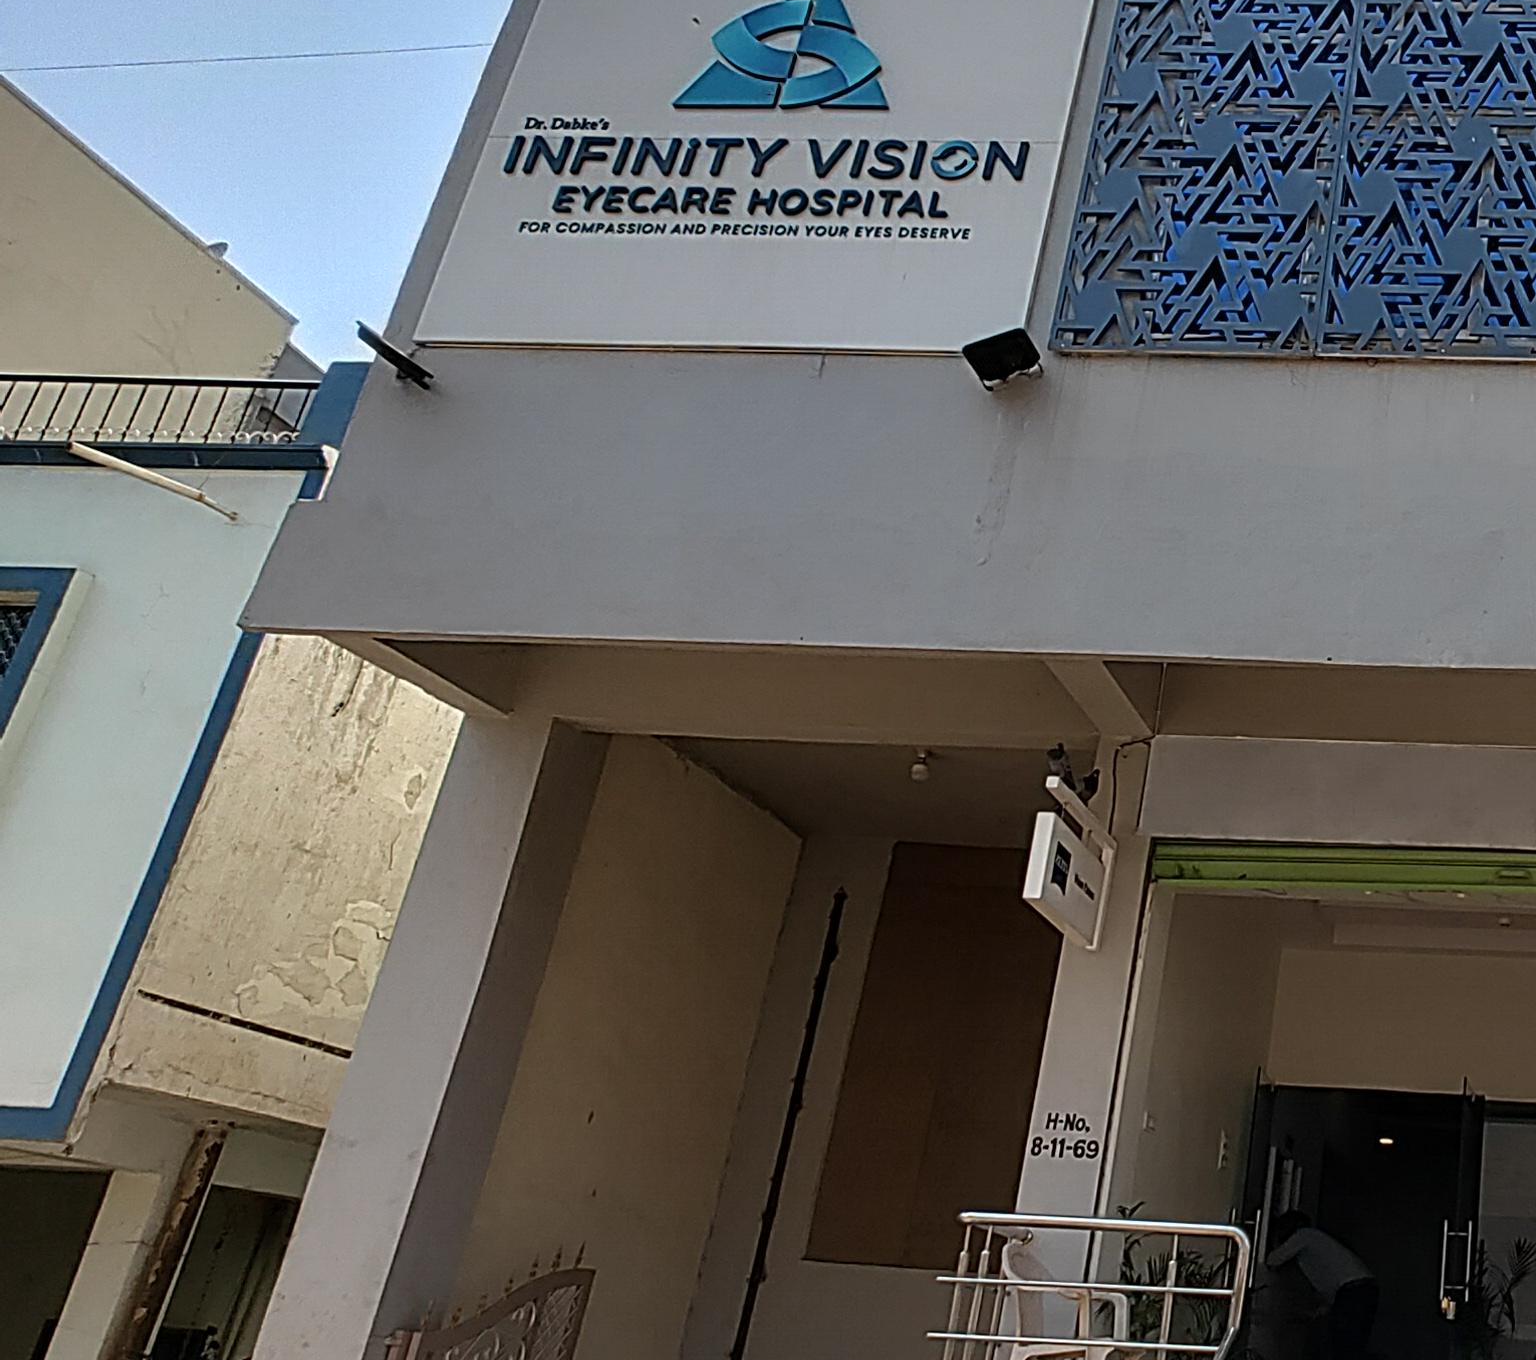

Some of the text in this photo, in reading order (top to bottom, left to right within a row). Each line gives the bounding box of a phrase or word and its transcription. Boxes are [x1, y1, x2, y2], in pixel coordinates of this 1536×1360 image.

[524, 117, 610, 131] Dr. Dabke's
[808, 139, 1030, 181] VISION
[552, 185, 948, 218] EYECARE HOSPITAL
[518, 221, 971, 240] FOR COMPASSION AND PRECISION YOUR EYES DESERVE
[1031, 1136, 1100, 1159] 8-11-69
